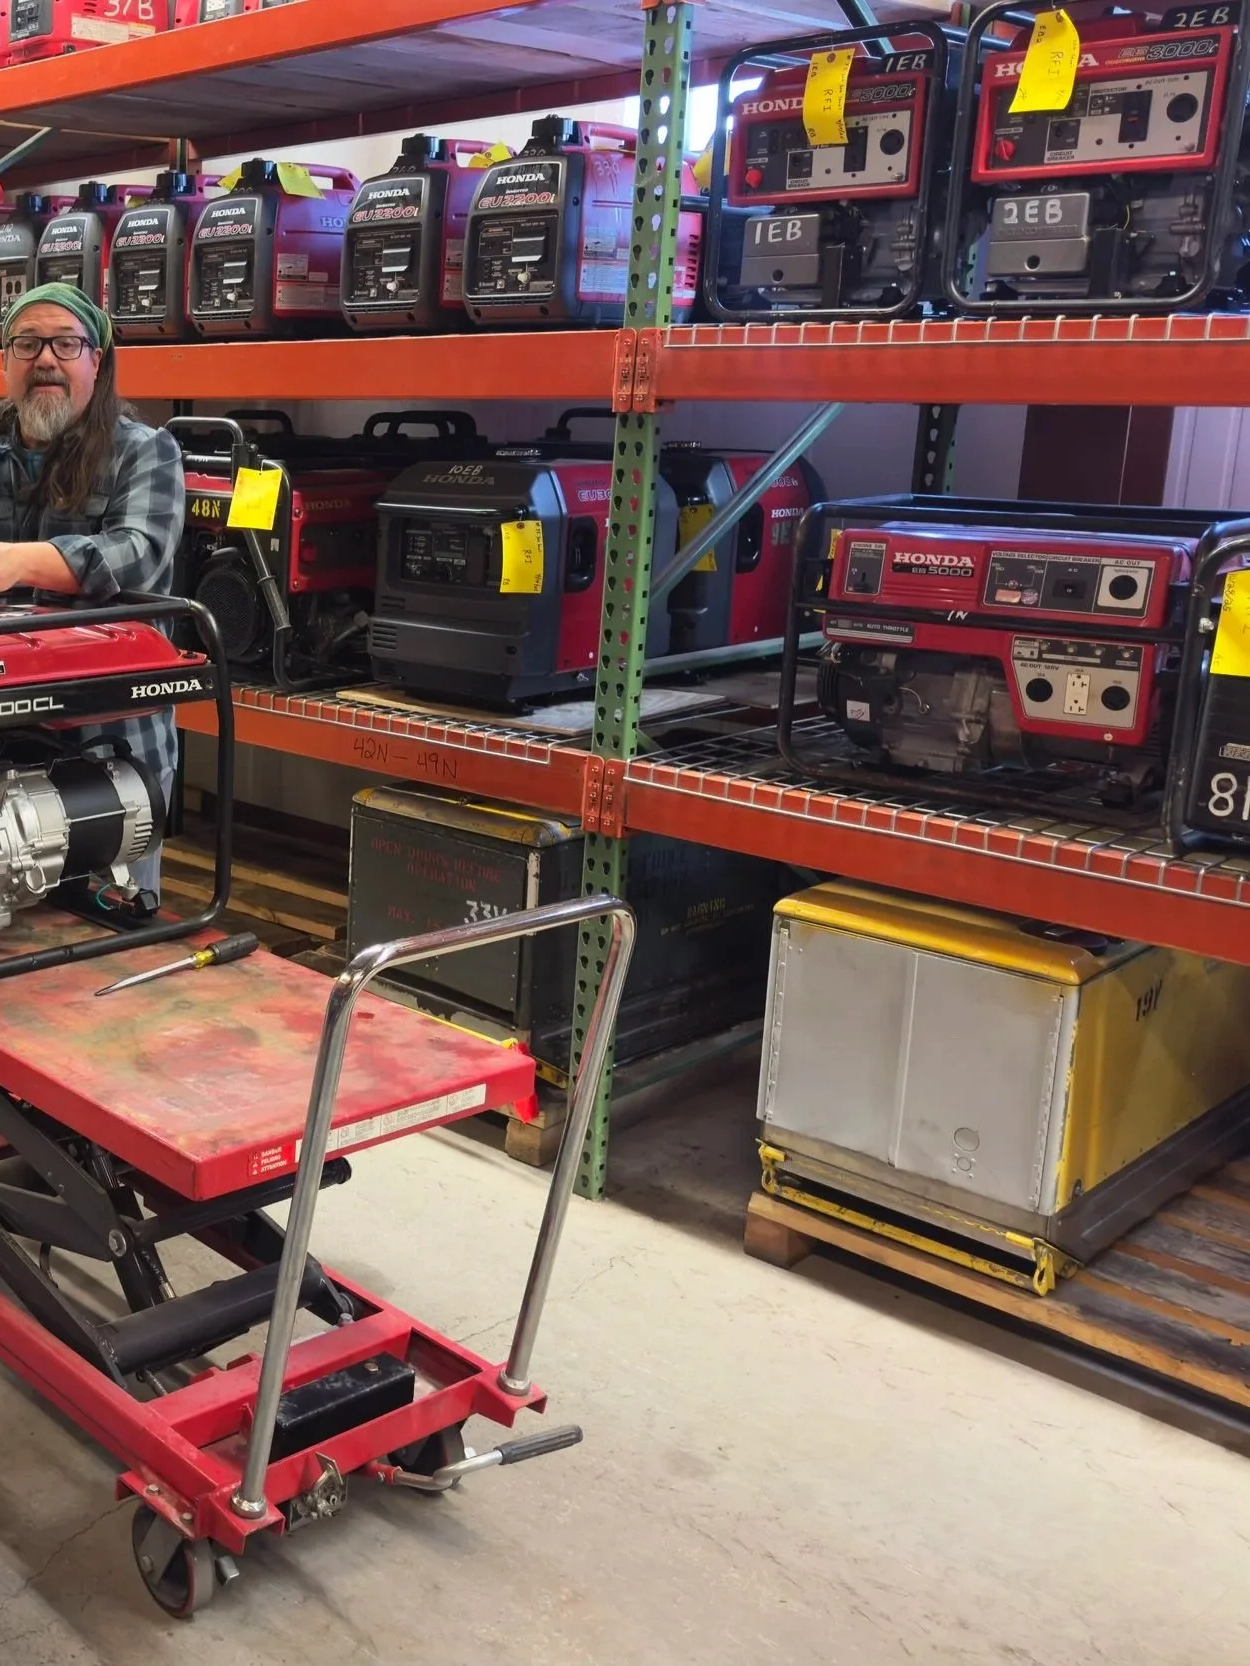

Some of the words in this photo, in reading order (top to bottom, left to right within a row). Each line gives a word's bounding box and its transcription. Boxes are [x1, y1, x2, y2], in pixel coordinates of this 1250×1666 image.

[1174, 6, 1230, 28] 2EB
[885, 54, 926, 73] 1EB
[994, 54, 1099, 78] HOA
[741, 97, 804, 115] HOND
[496, 172, 546, 185] HONDA
[368, 187, 411, 200] HONDA
[478, 191, 554, 209] EU2200i
[211, 207, 246, 218] HONDA
[353, 206, 419, 222] EU2200i
[1003, 199, 1063, 224] 2EB
[51, 225, 78, 235] HONDA
[127, 217, 159, 228] HONDA
[198, 223, 253, 239] EU2200i
[754, 220, 802, 244] 1EB
[116, 233, 165, 247] EU2200i
[449, 464, 484, 476] 10EB
[422, 474, 495, 485] HONDA
[191, 498, 221, 519] 48N
[893, 552, 975, 568] HONDA
[882, 624, 910, 633] THROTTLE
[130, 678, 203, 698] HONDA
[353, 737, 389, 764] 42N
[416, 752, 458, 779] 49N
[370, 835, 400, 855] OPEN
[407, 862, 477, 893] OPERATION
[260, 1160, 287, 1173] ATTENTION
